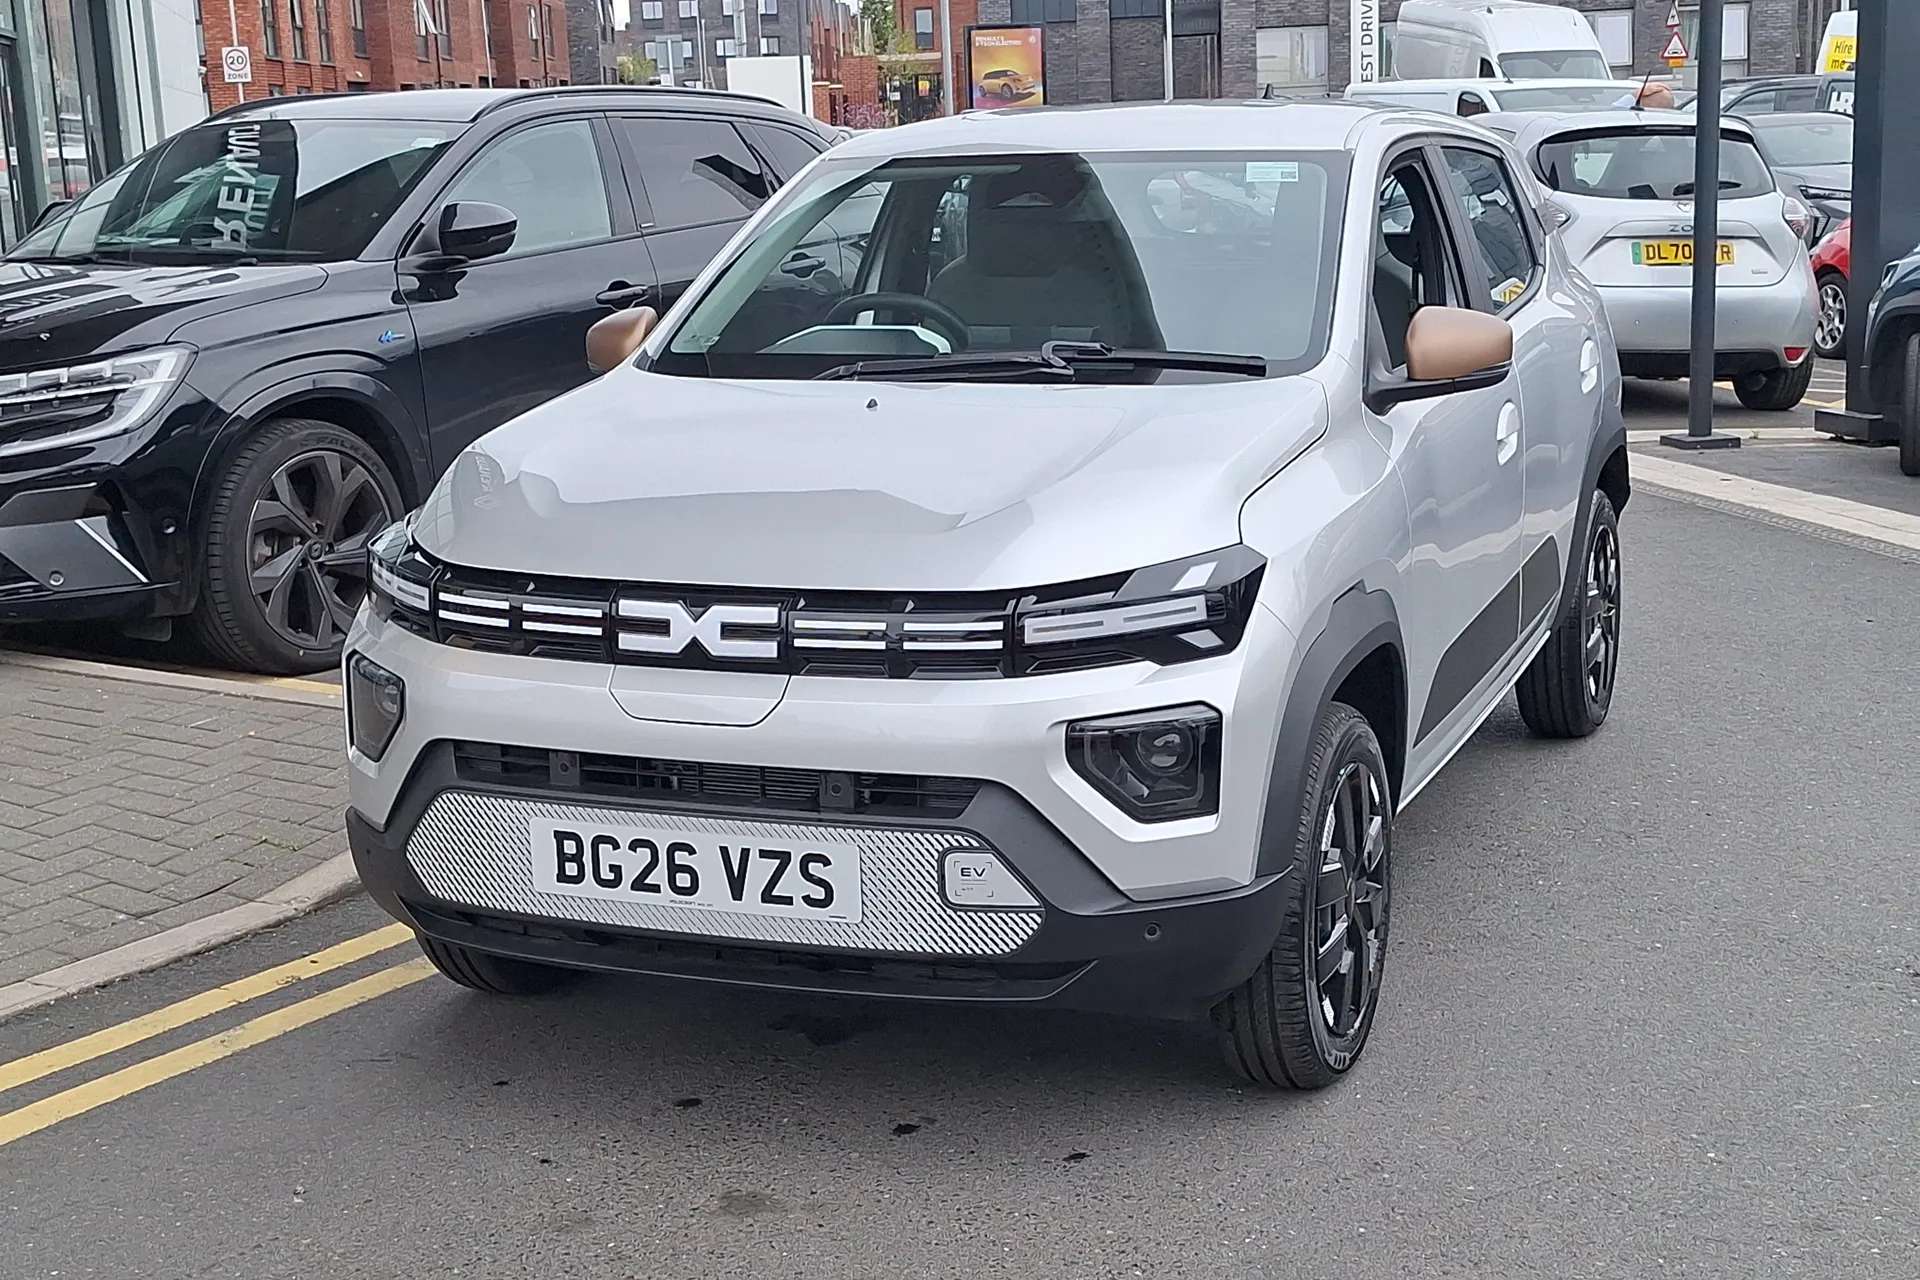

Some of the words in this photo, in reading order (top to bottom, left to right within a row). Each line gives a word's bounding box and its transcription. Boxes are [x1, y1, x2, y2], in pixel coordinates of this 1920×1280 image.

[1361, 0, 1373, 45] DRIV
[1834, 41, 1853, 54] Hire
[229, 56, 244, 65] 20
[1361, 51, 1373, 82] EST
[1831, 59, 1845, 69] me
[1669, 224, 1694, 232] ZO
[1645, 244, 1692, 260] DL70
[553, 829, 699, 897] BG26
[719, 845, 834, 909] VZS
[961, 867, 986, 877] EV
